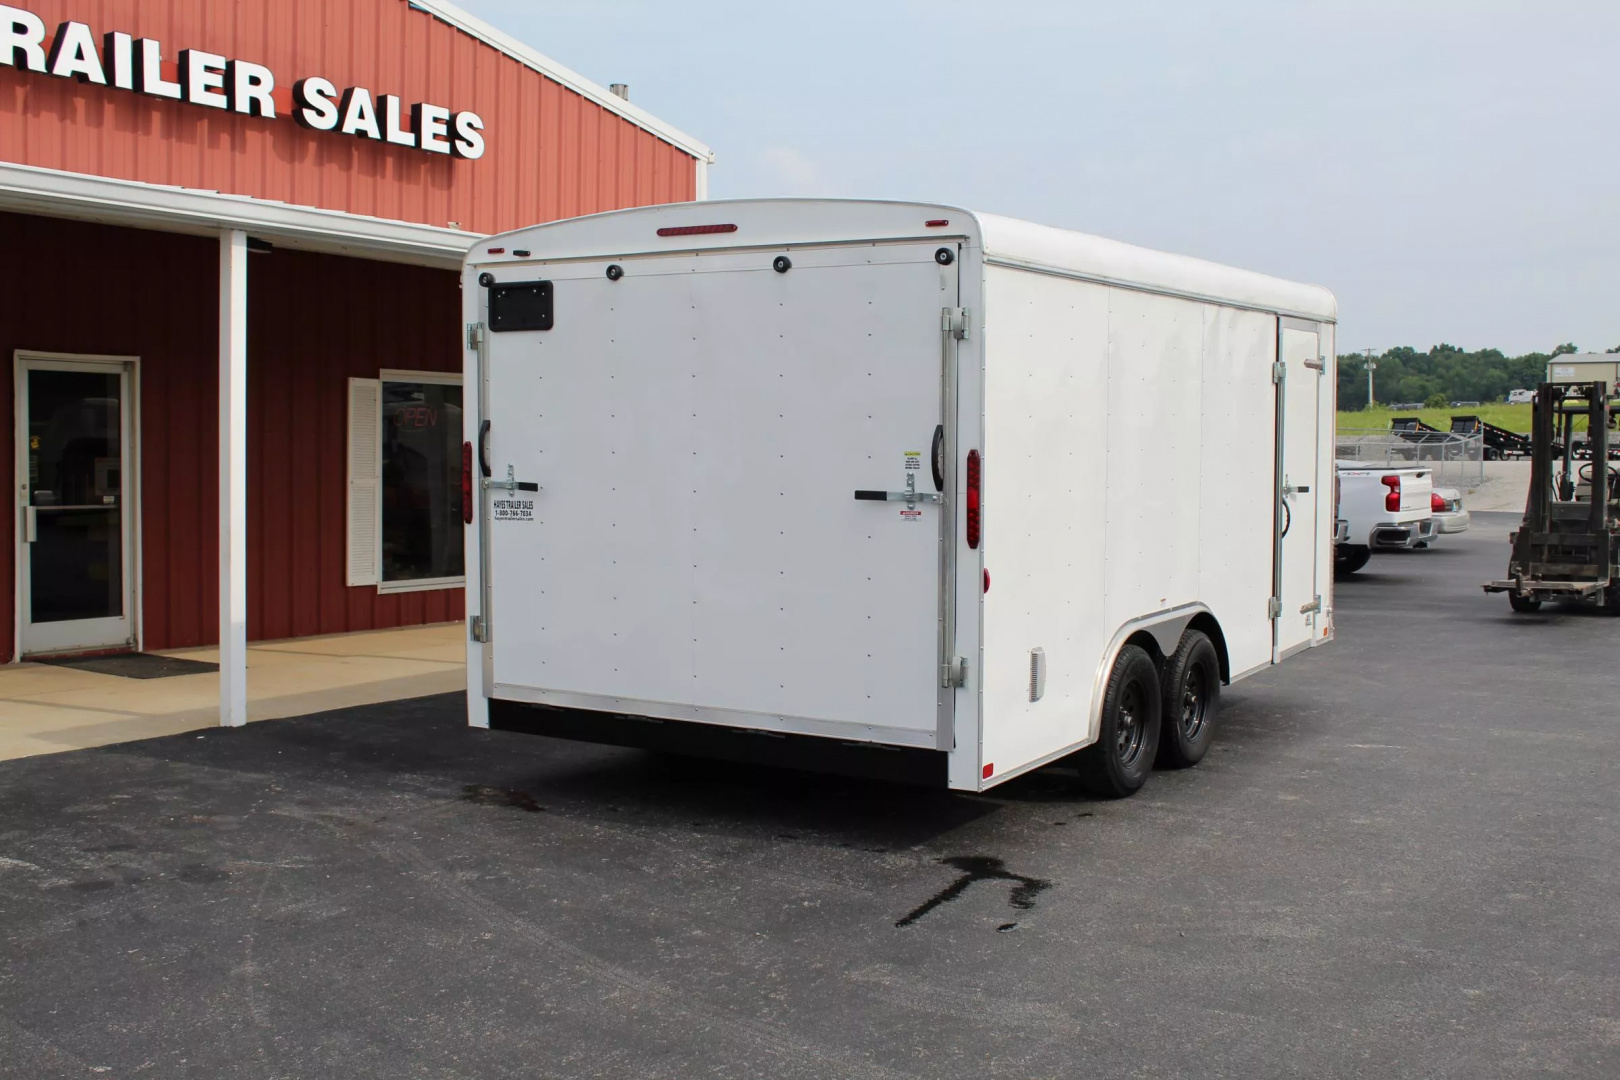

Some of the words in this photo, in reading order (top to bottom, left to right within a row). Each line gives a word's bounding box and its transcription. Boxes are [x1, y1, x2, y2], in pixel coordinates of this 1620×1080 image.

[0, 4, 277, 119] RAILER
[300, 75, 486, 160] SALES
[393, 406, 438, 428] OPEN
[494, 500, 505, 509] HAYES
[506, 500, 521, 509] TRAILER
[522, 500, 534, 509] SALES
